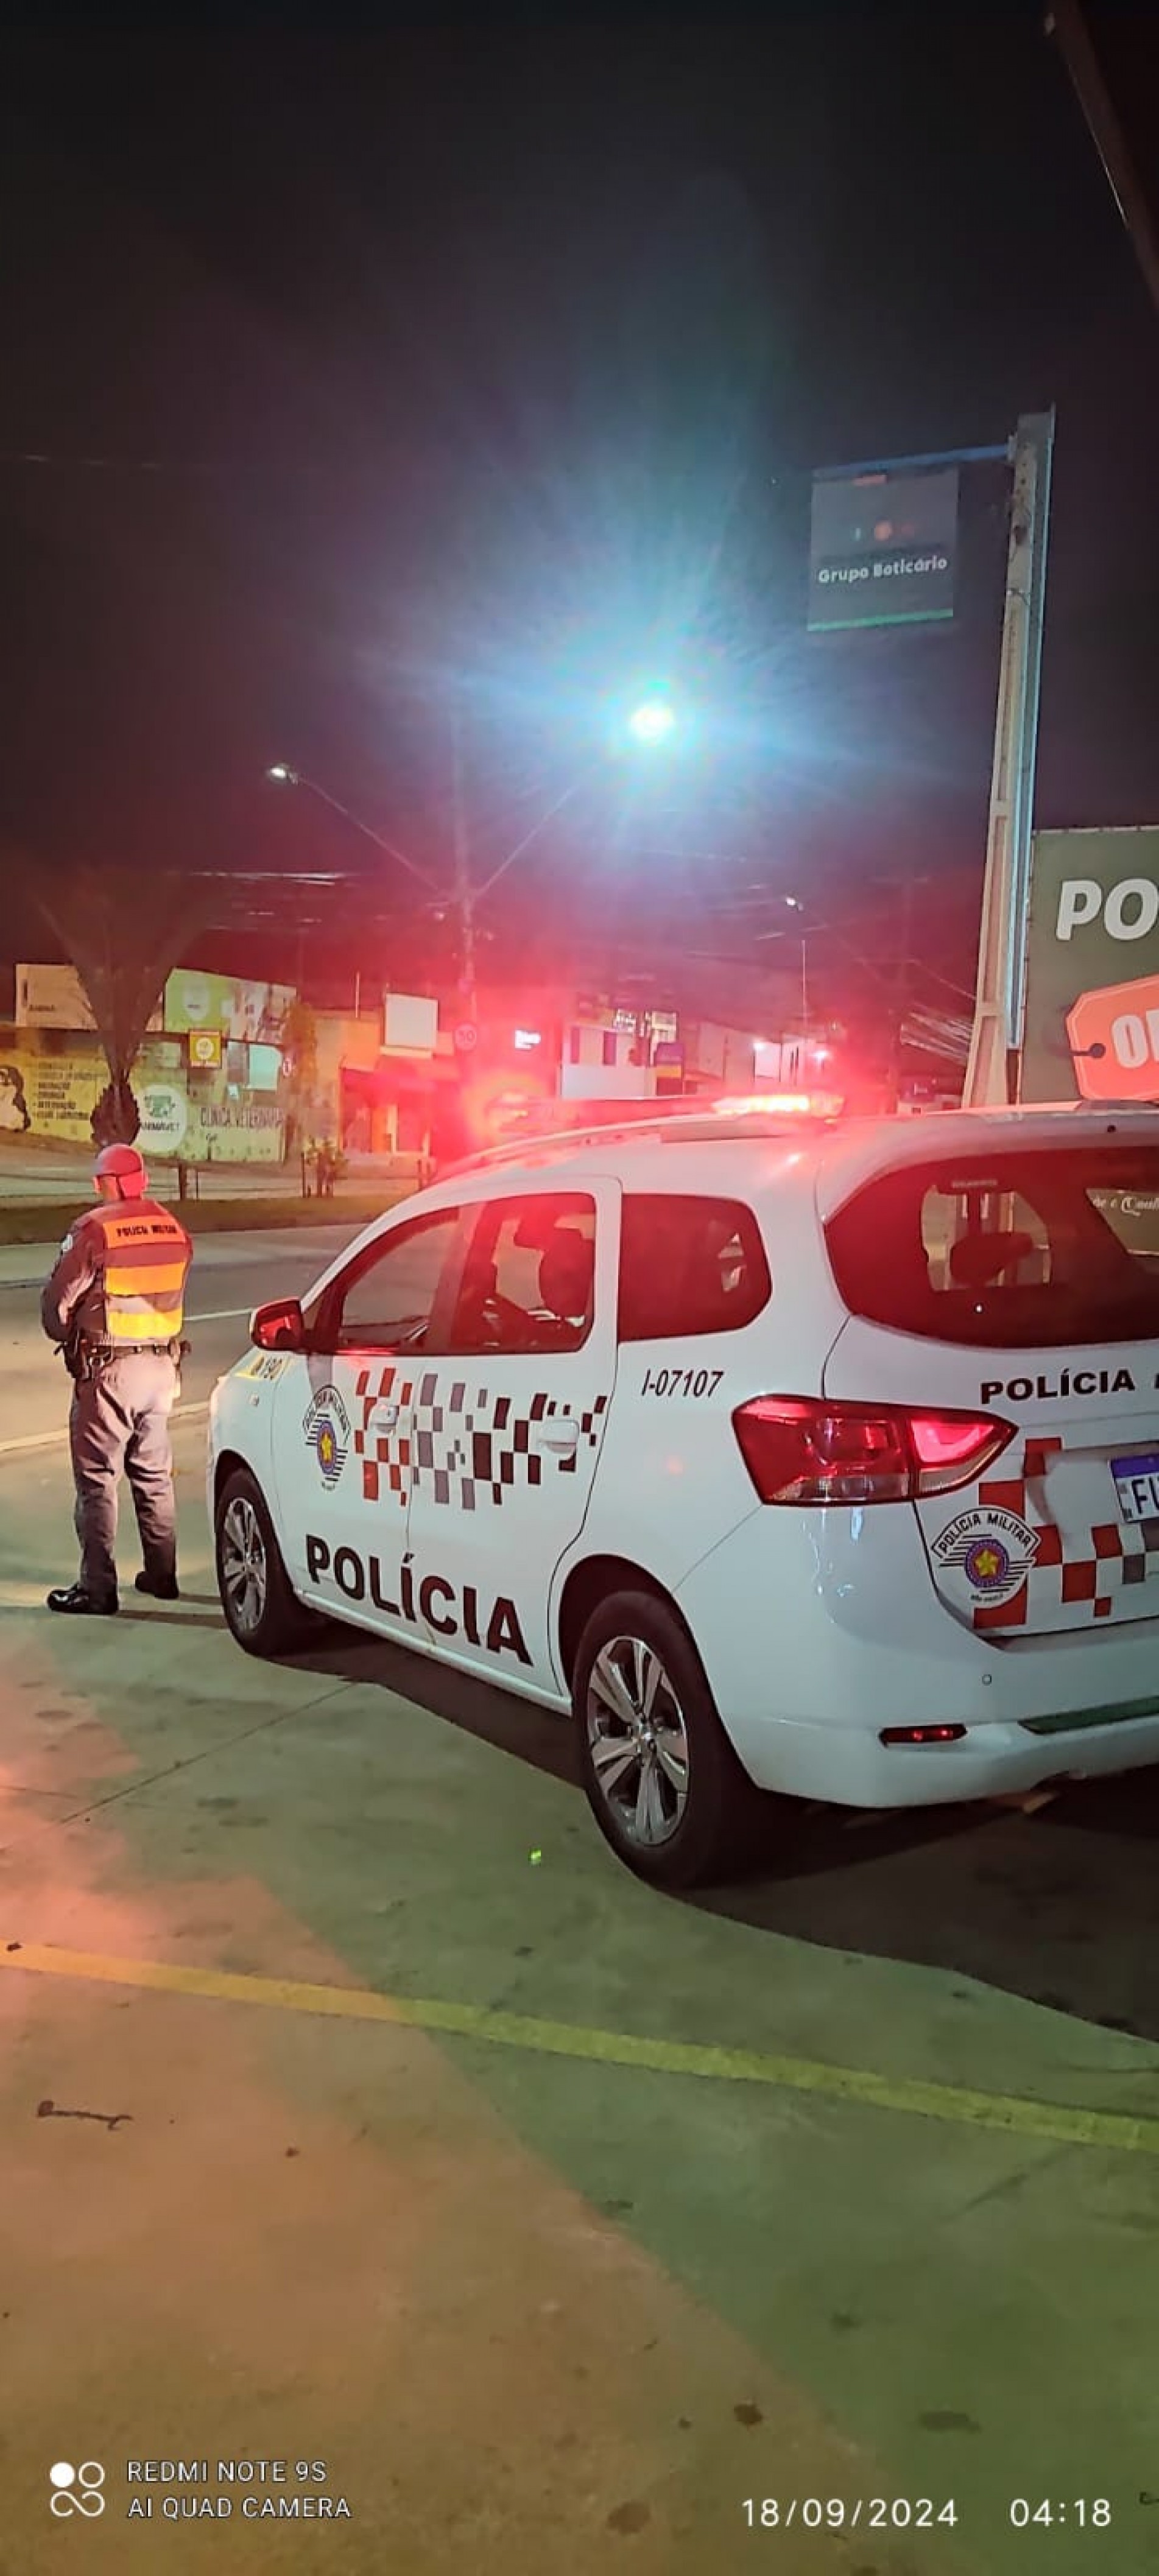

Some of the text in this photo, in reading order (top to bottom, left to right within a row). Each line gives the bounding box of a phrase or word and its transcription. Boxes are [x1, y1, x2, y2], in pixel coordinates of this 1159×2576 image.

[819, 555, 948, 583] Grupo Boticário
[641, 1369, 724, 1398] I-07107
[981, 1368, 1135, 1404] POLÍCIA
[988, 1513, 1032, 1546] MILITAR
[306, 1534, 534, 1667] POLÍCIA
